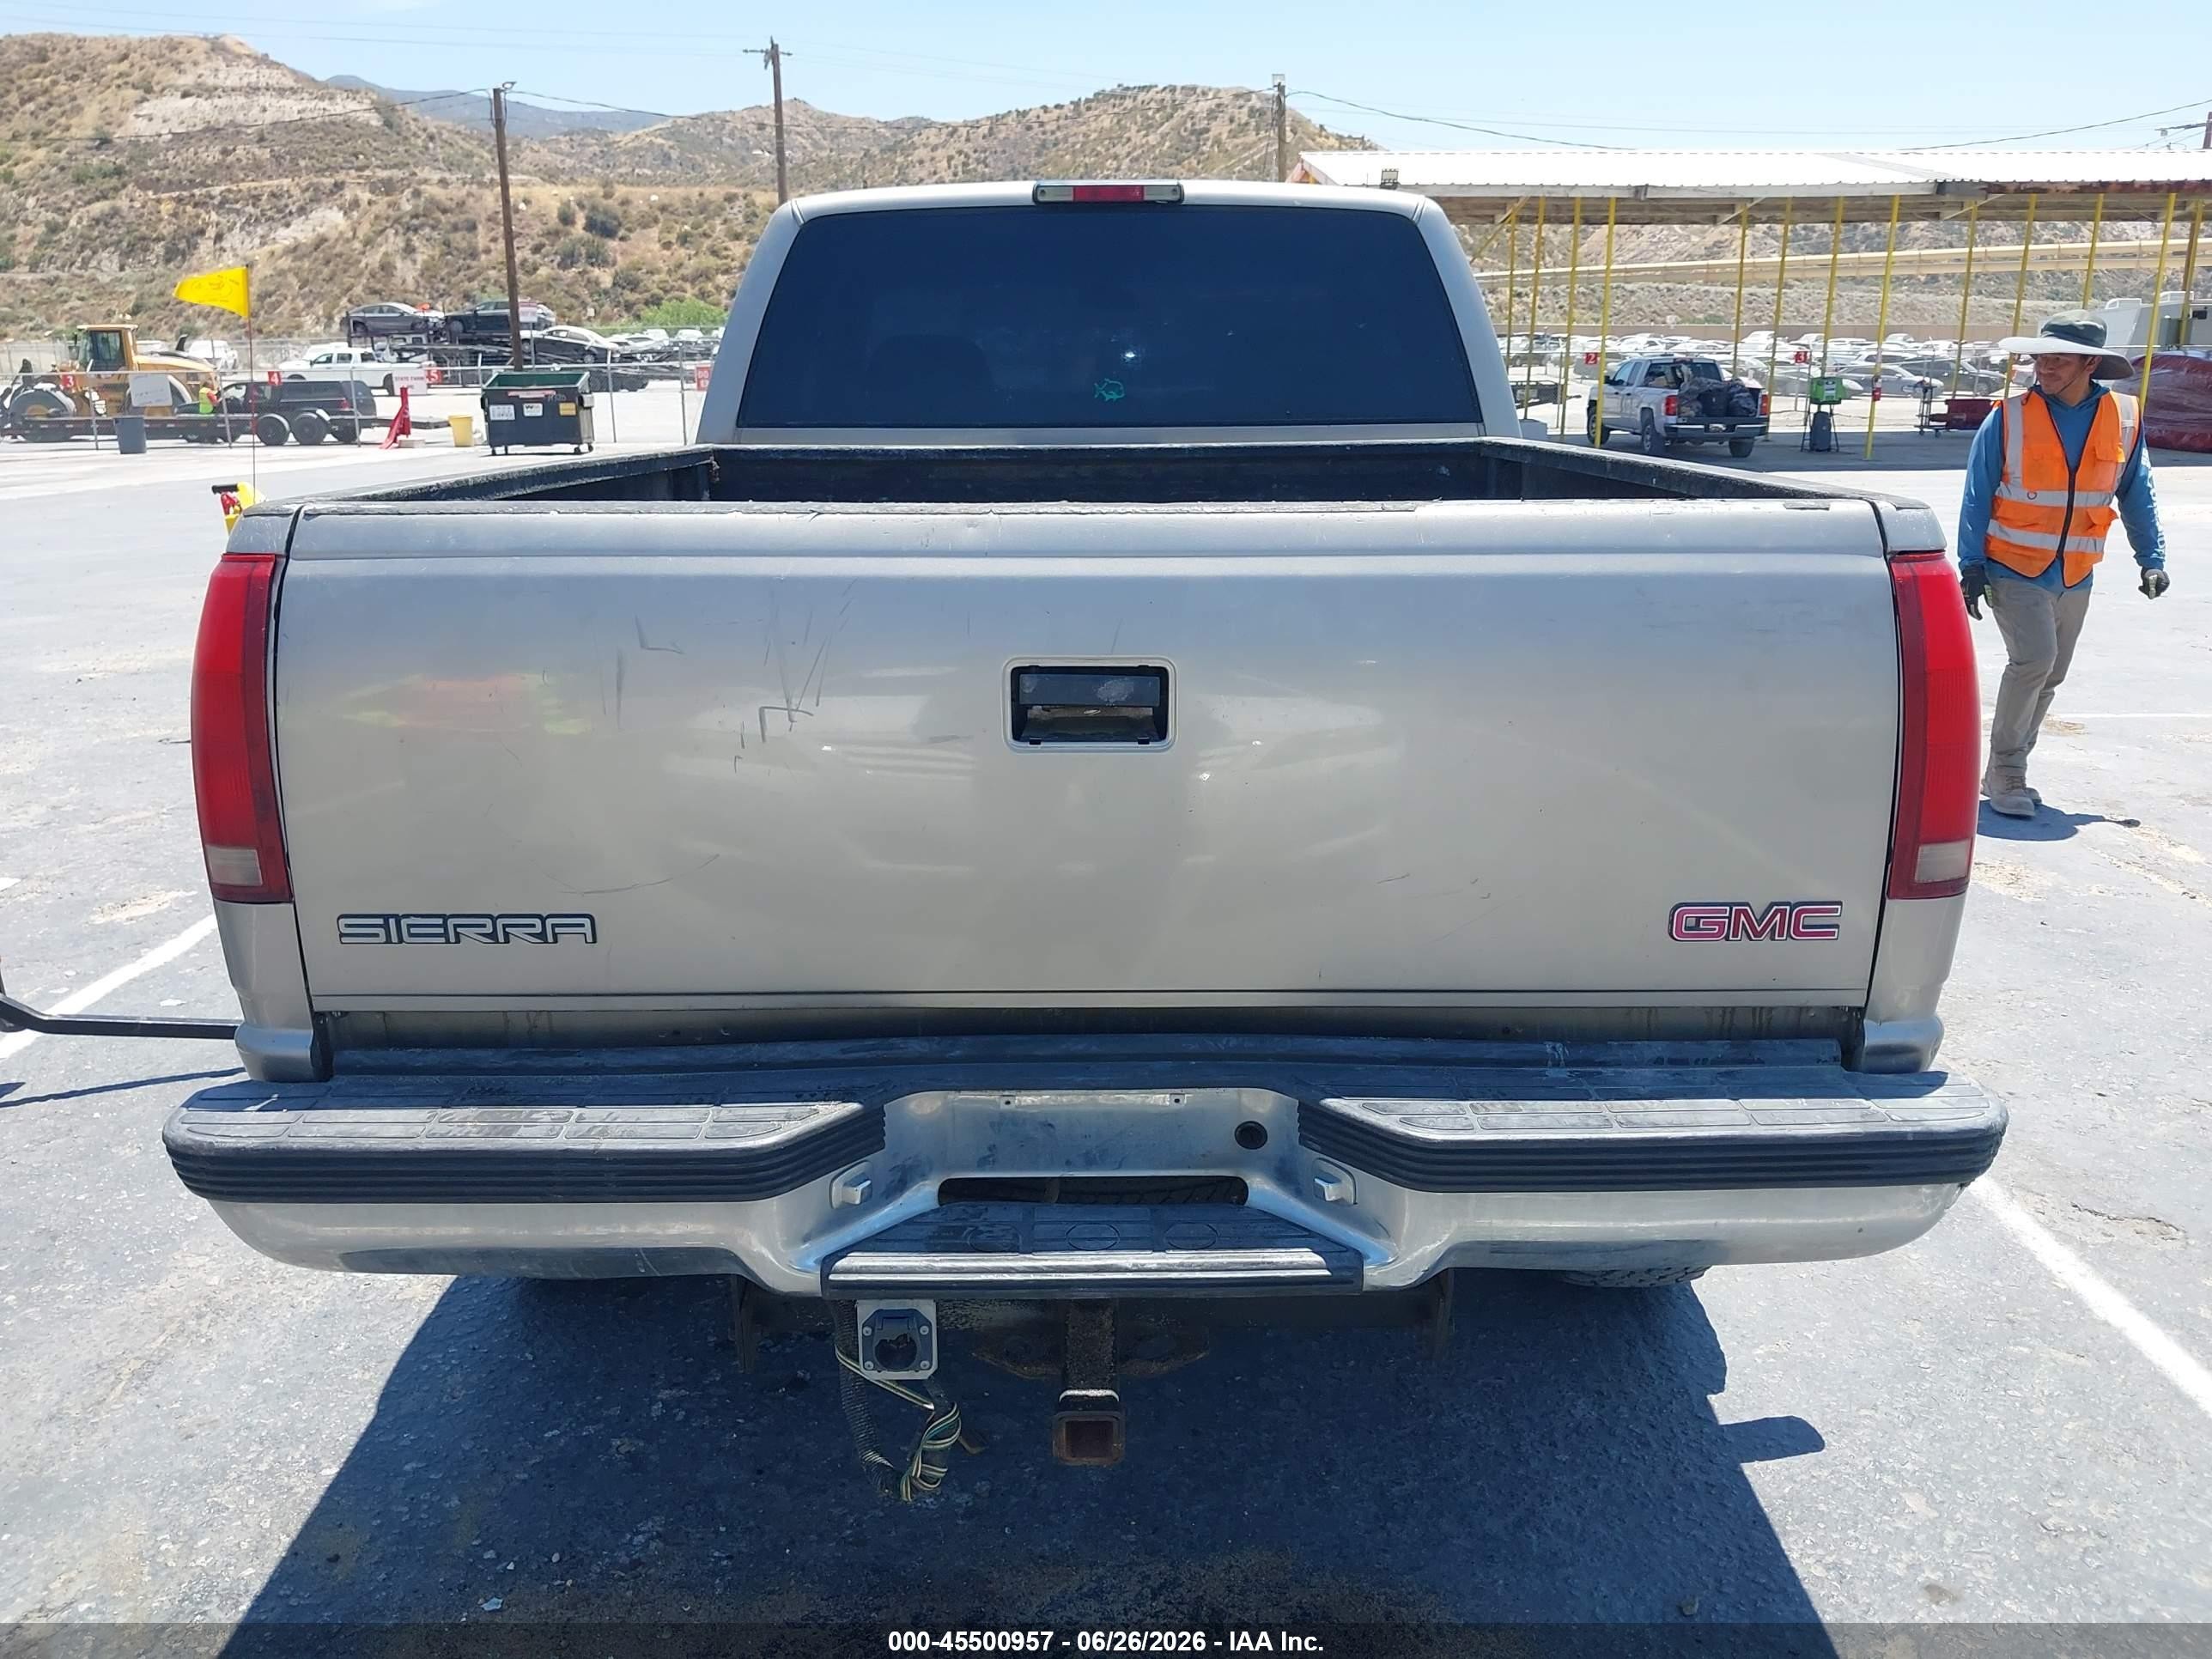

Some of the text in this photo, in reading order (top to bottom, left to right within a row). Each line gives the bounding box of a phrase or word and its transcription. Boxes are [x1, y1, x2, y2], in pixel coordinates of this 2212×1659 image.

[1588, 353, 1595, 364] 2
[1797, 352, 1805, 362] 3
[66, 375, 74, 387] 3
[270, 372, 279, 386] 4
[1668, 902, 1843, 941] GMC
[337, 914, 597, 945] SIERRA
